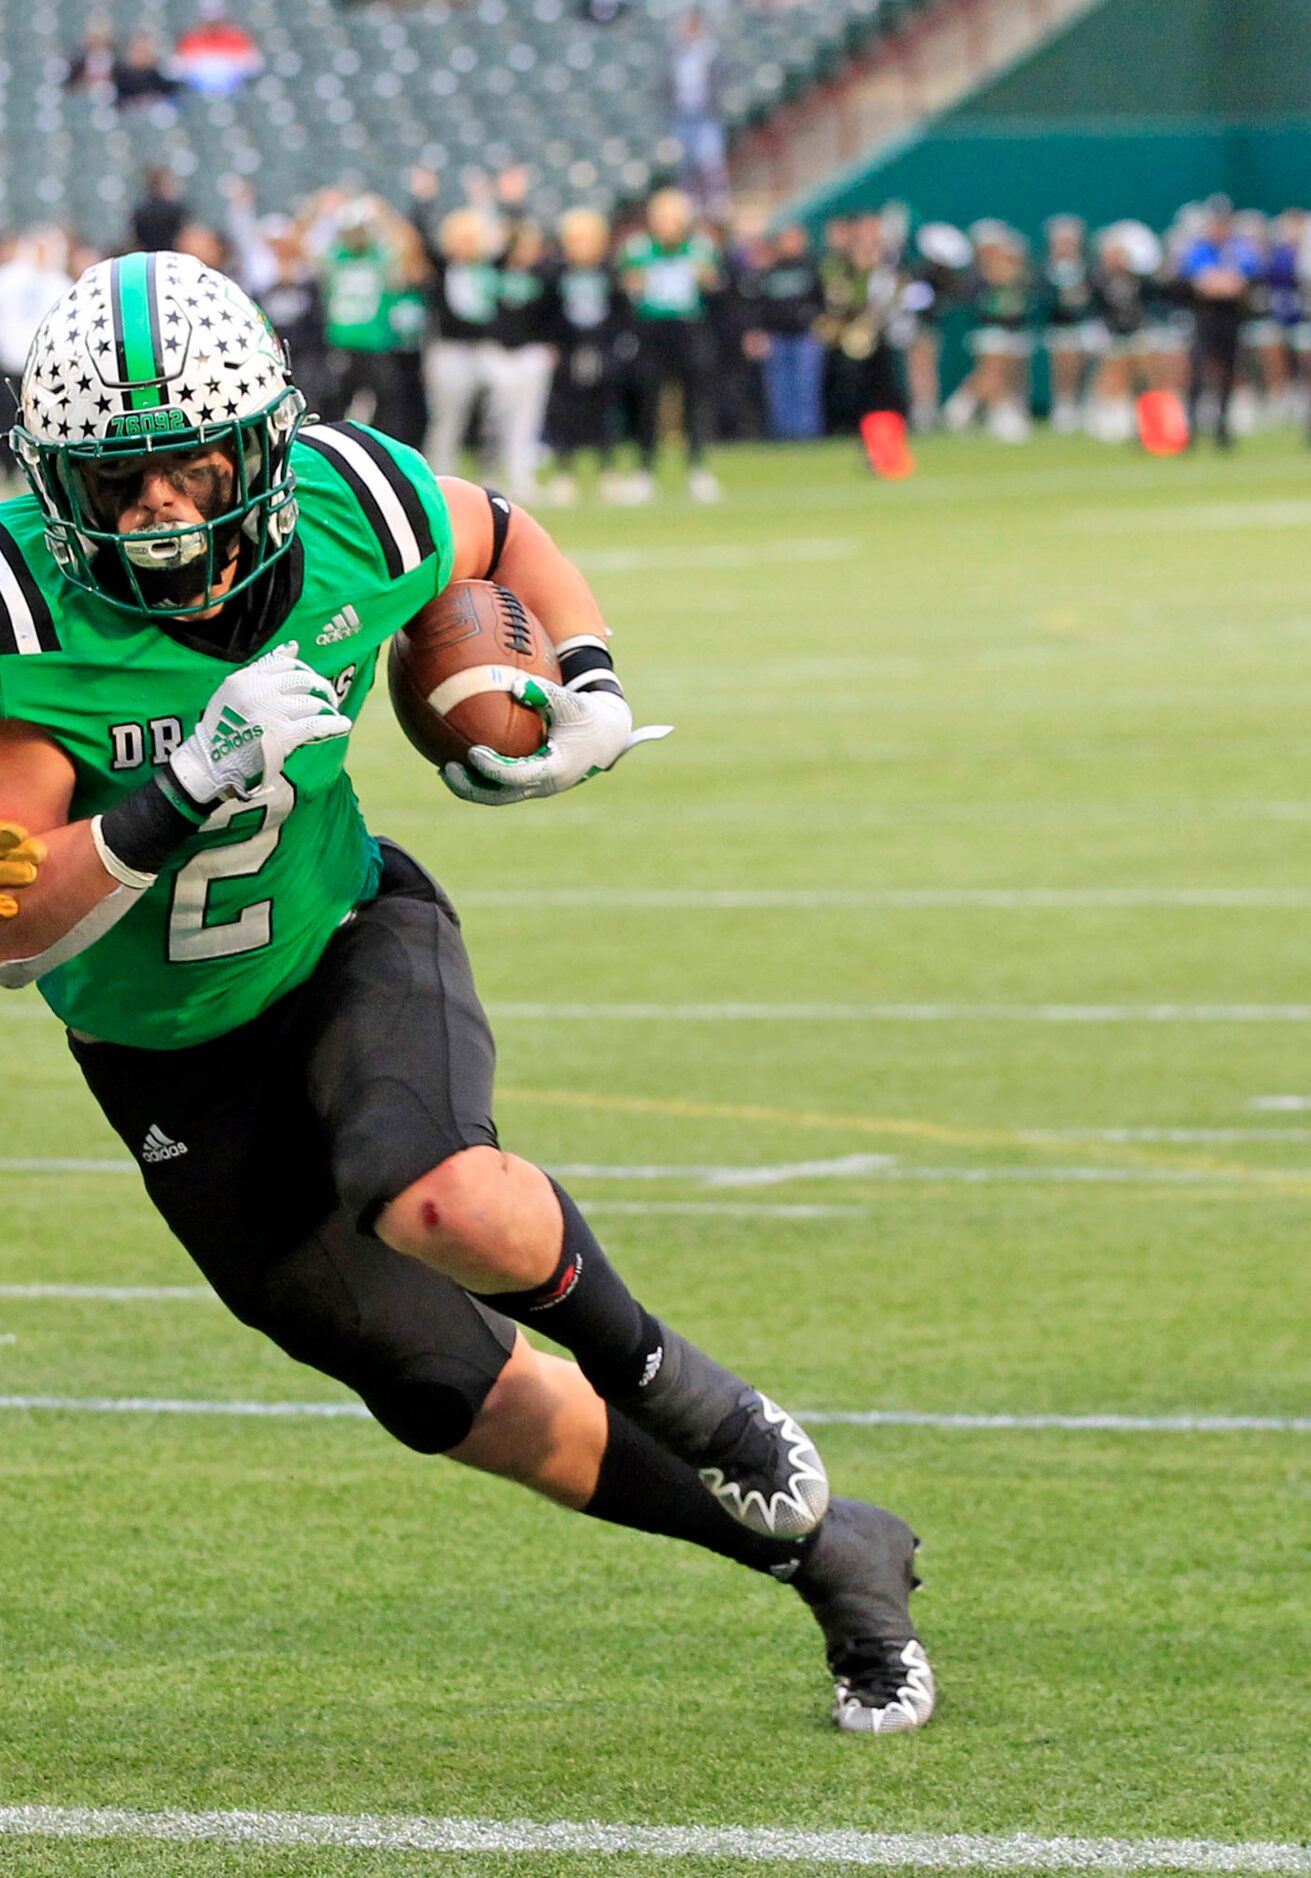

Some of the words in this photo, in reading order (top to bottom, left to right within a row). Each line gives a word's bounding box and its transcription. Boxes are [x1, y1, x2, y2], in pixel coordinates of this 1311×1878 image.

[111, 409, 186, 438] 76092
[210, 722, 265, 763] adidas
[167, 771, 297, 964] 2
[142, 1141, 188, 1163] adidas
